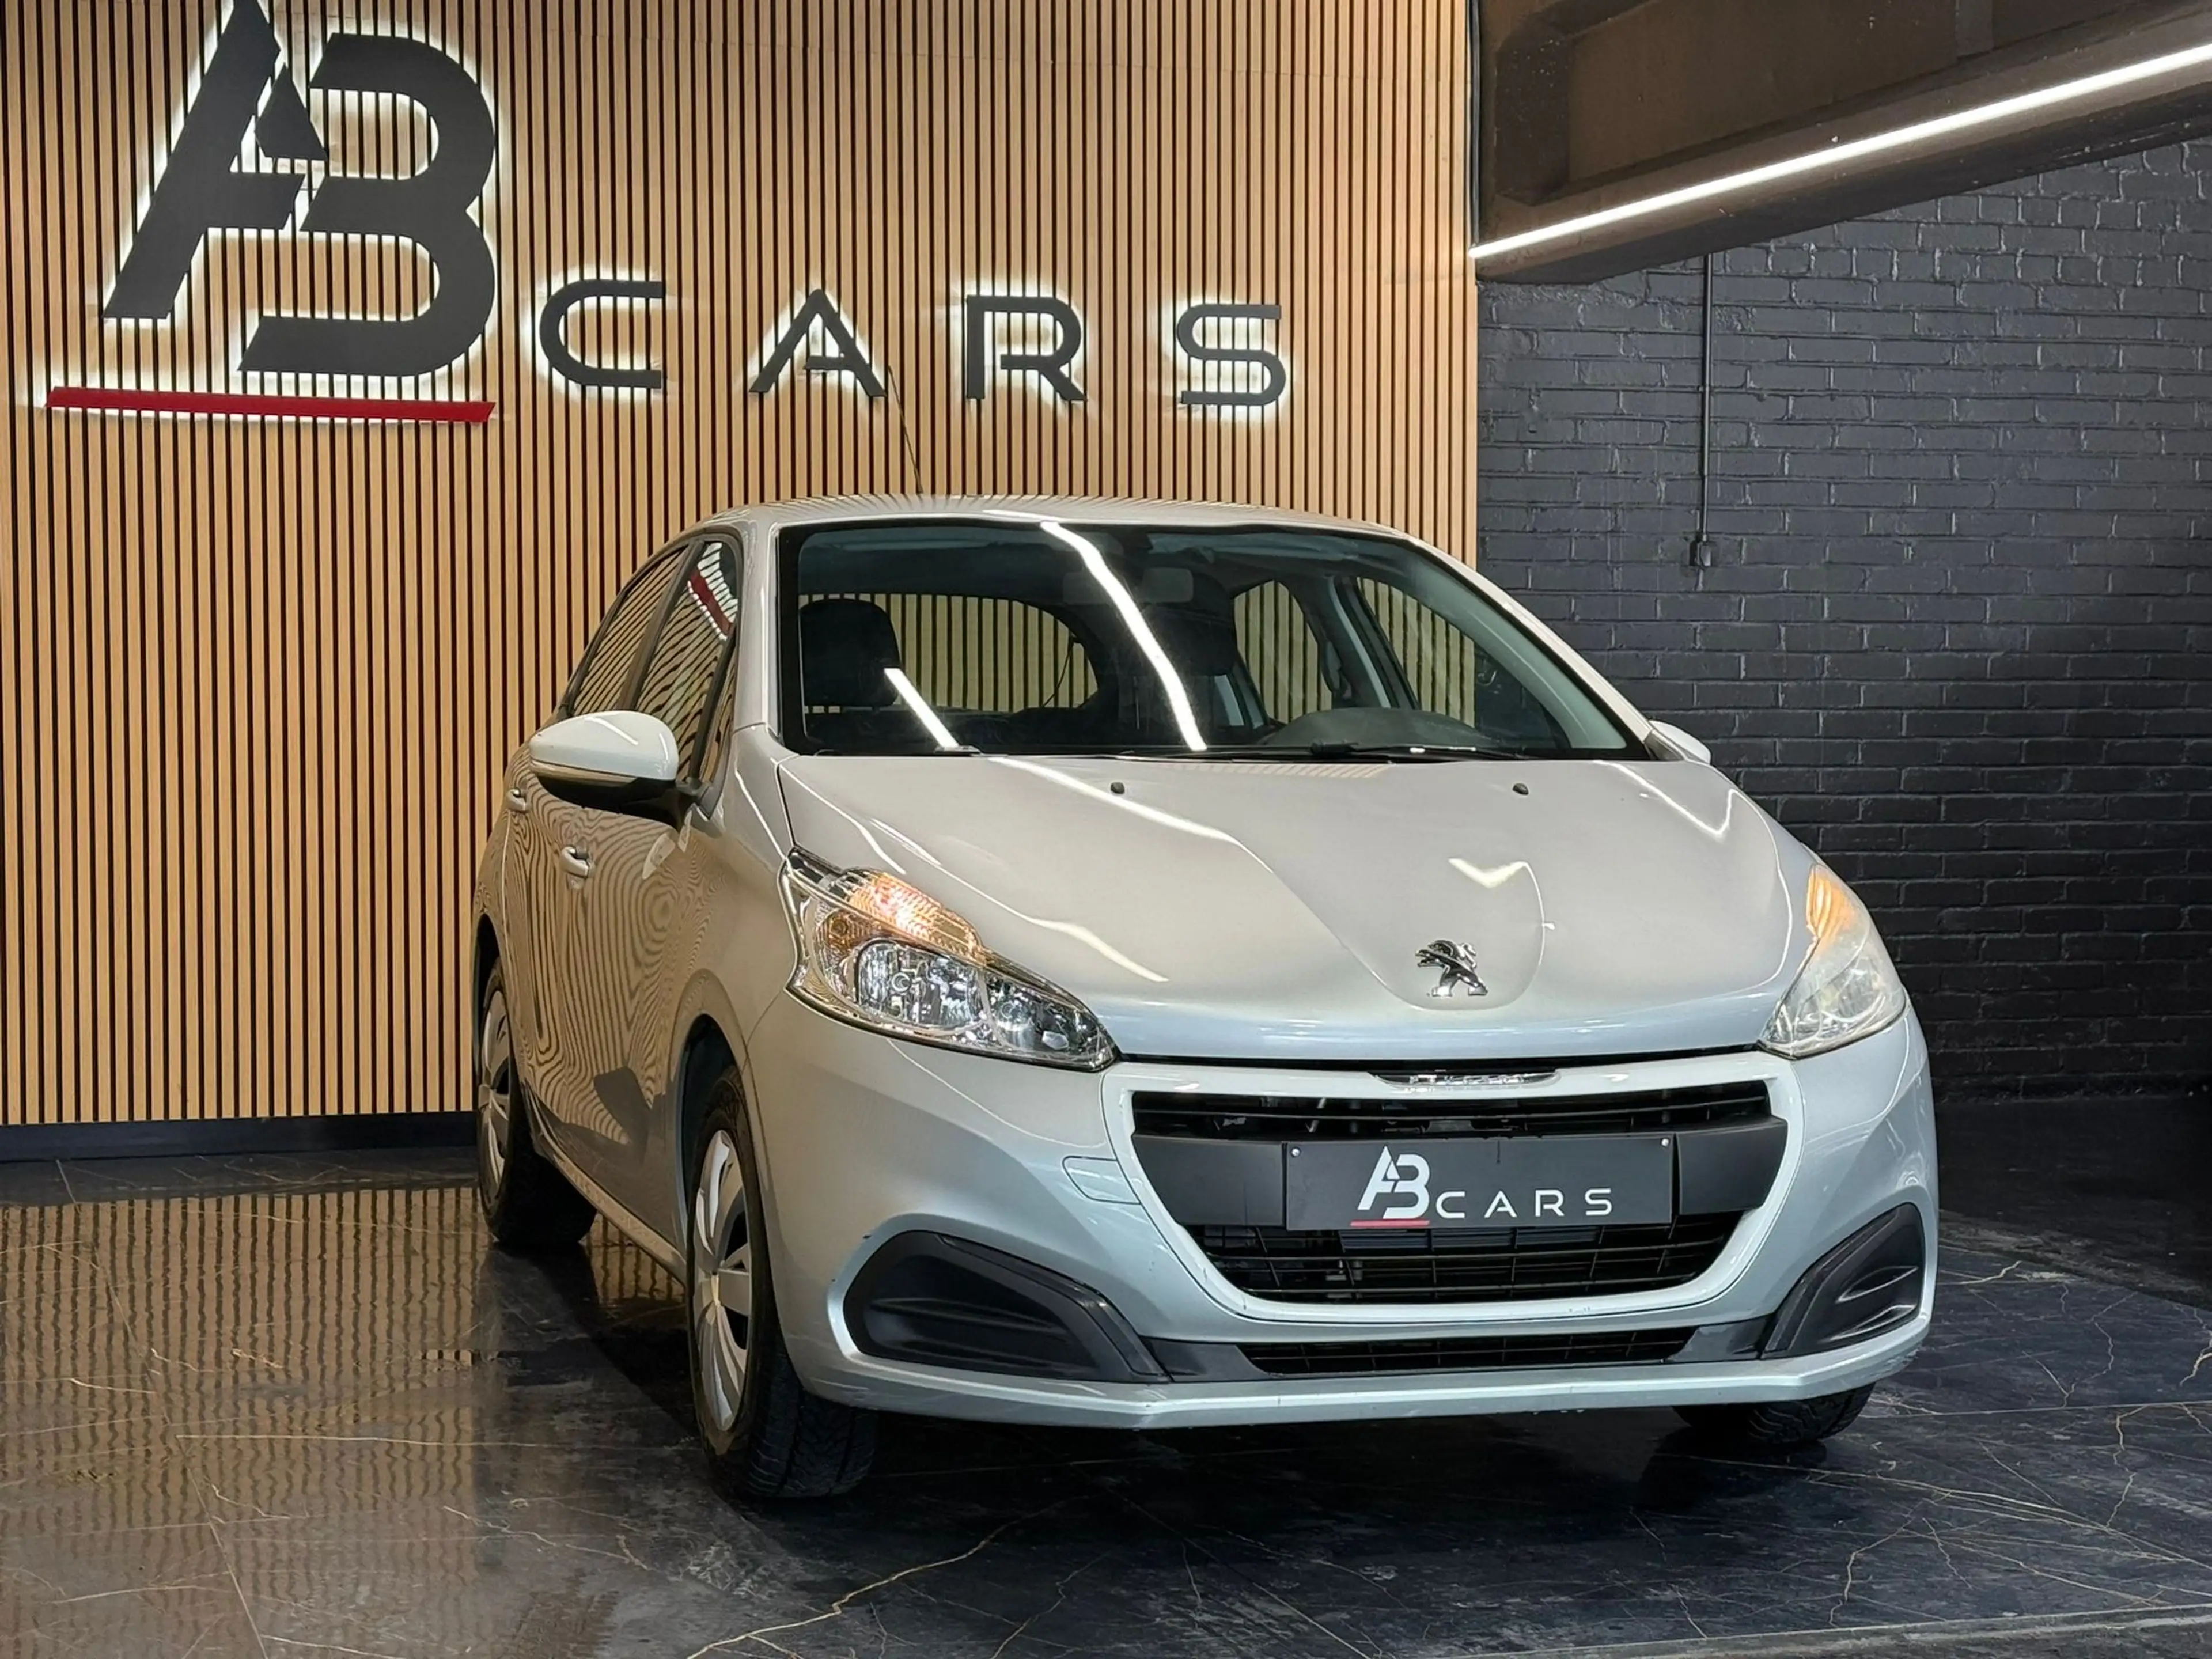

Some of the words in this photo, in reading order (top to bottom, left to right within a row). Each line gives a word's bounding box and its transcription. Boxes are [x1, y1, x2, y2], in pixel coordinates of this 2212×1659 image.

[103, 0, 495, 377] AB
[539, 279, 1286, 406] CARS
[1358, 1145, 1430, 1219] AB
[1436, 1188, 1612, 1218] CARS
